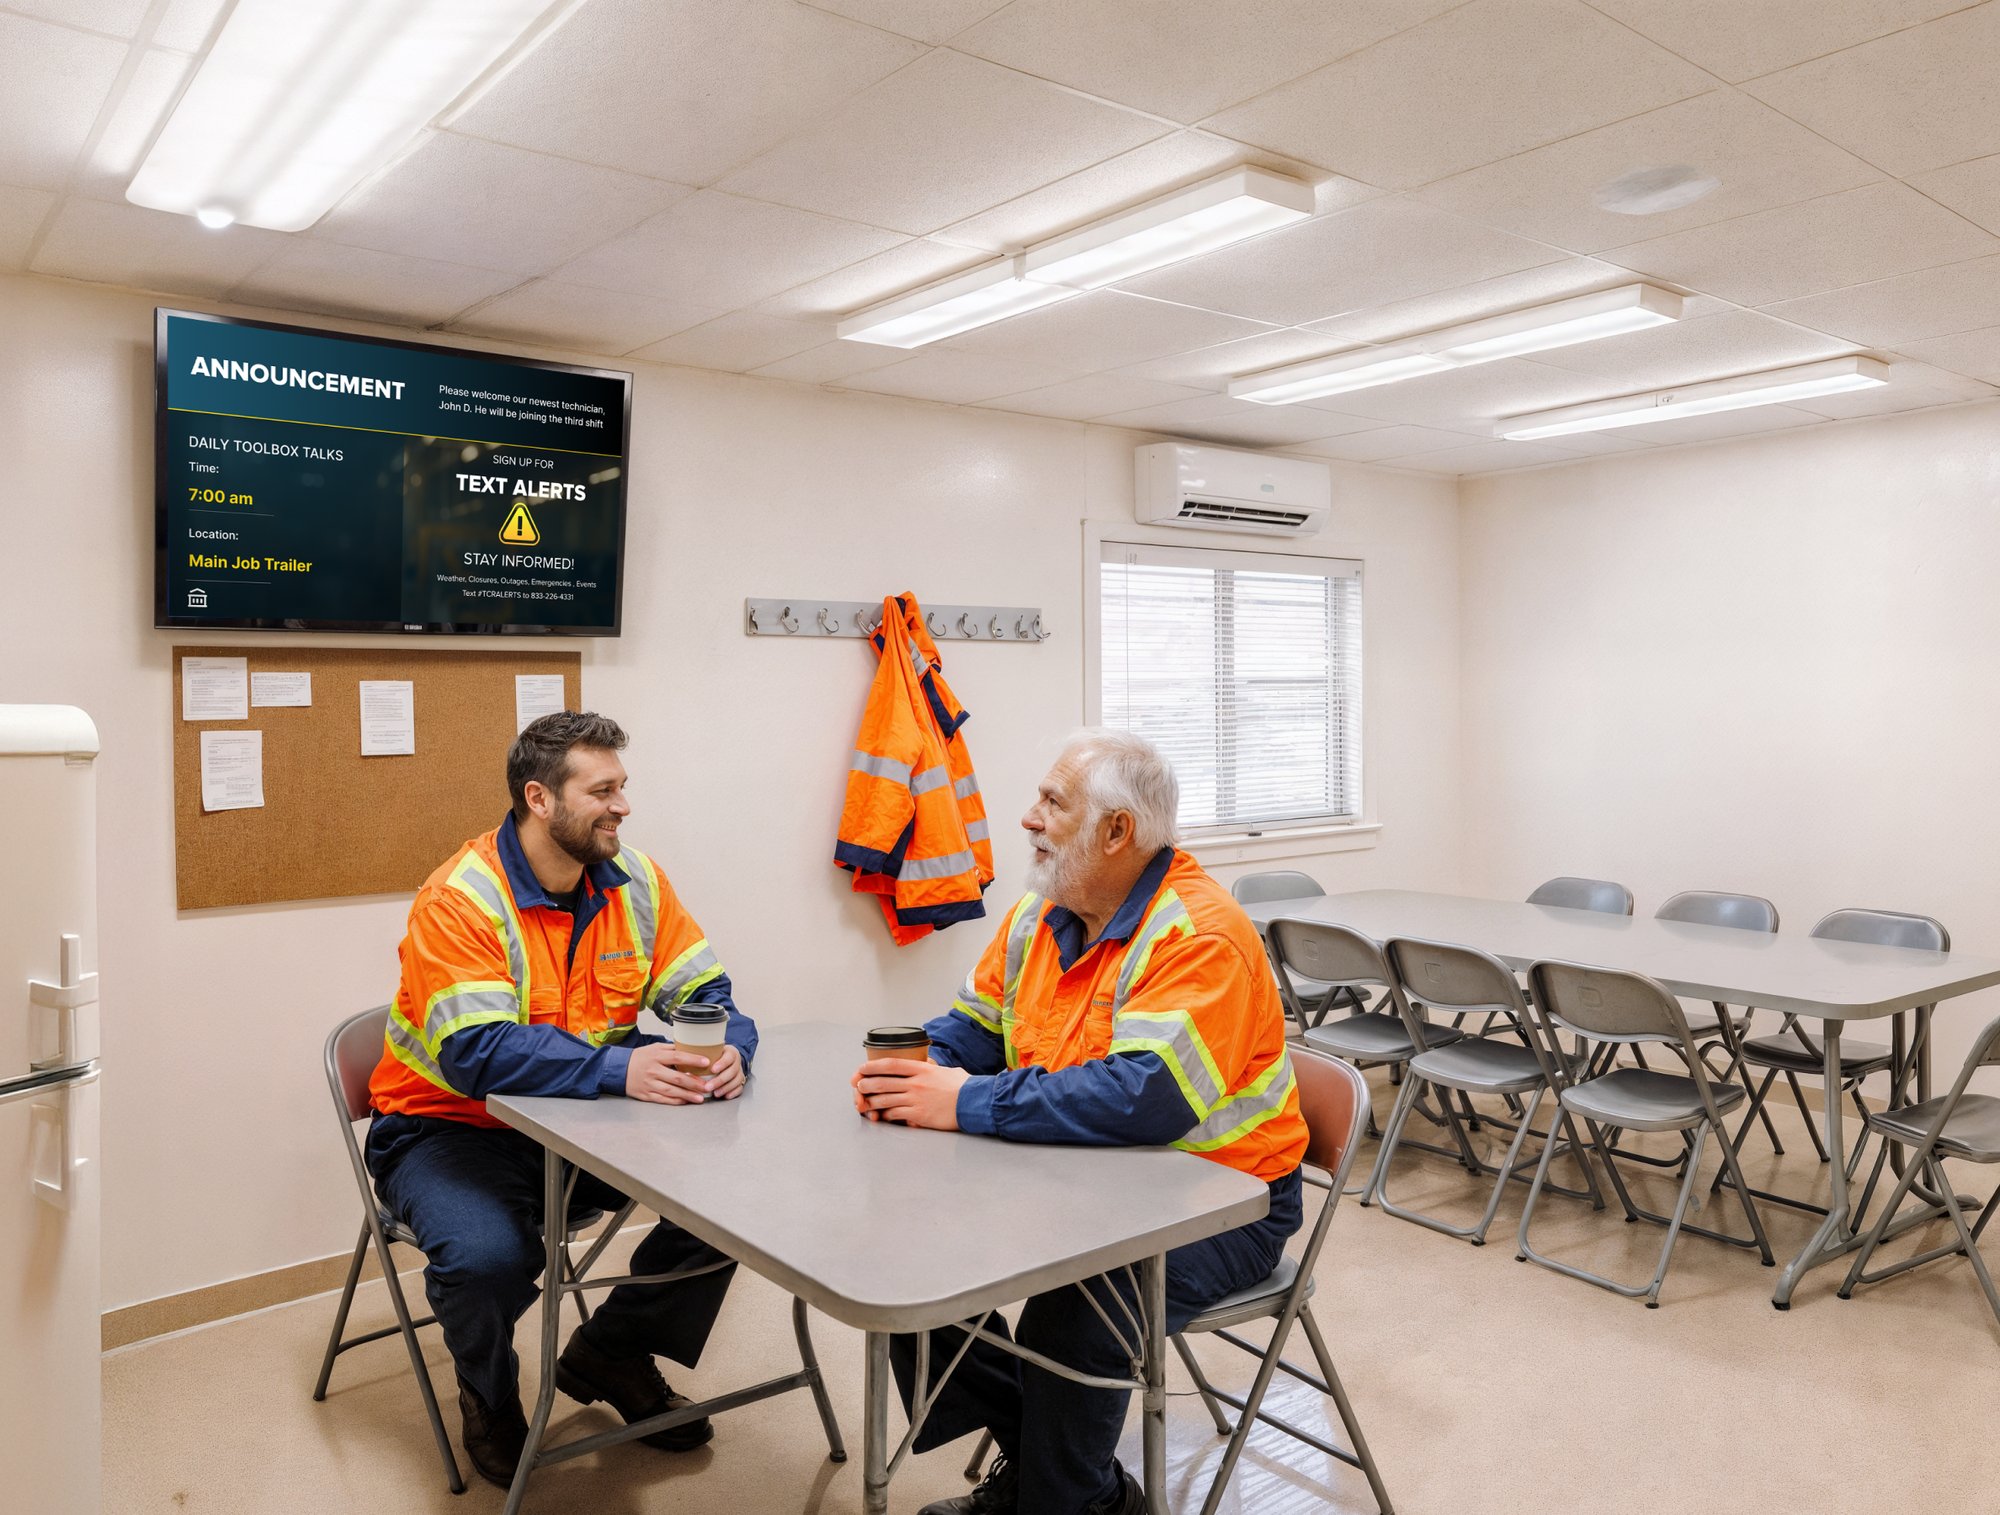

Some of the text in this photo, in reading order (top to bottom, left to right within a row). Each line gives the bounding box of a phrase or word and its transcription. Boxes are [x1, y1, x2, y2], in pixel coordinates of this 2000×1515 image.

[190, 356, 406, 400] ANNOUNCEMENT
[439, 384, 606, 416] Please welcome our newest technician,
[438, 401, 604, 429] John D. He will be joining the third shift
[189, 436, 344, 461] DAILY TOOLBOX TALKS
[188, 461, 219, 474] Time:
[492, 454, 554, 470] SIGN UP FOR
[455, 473, 587, 501] TEXT ALERTS
[188, 488, 253, 505] 7:00 am
[188, 528, 239, 540] Location:
[188, 554, 312, 572] Main Job Trailer
[463, 552, 575, 570] STAY INFORMED!
[576, 580, 597, 589] Events
[462, 589, 476, 597] Text
[477, 590, 522, 599] #TCRALERTS
[530, 592, 574, 601] 833-226-4331
